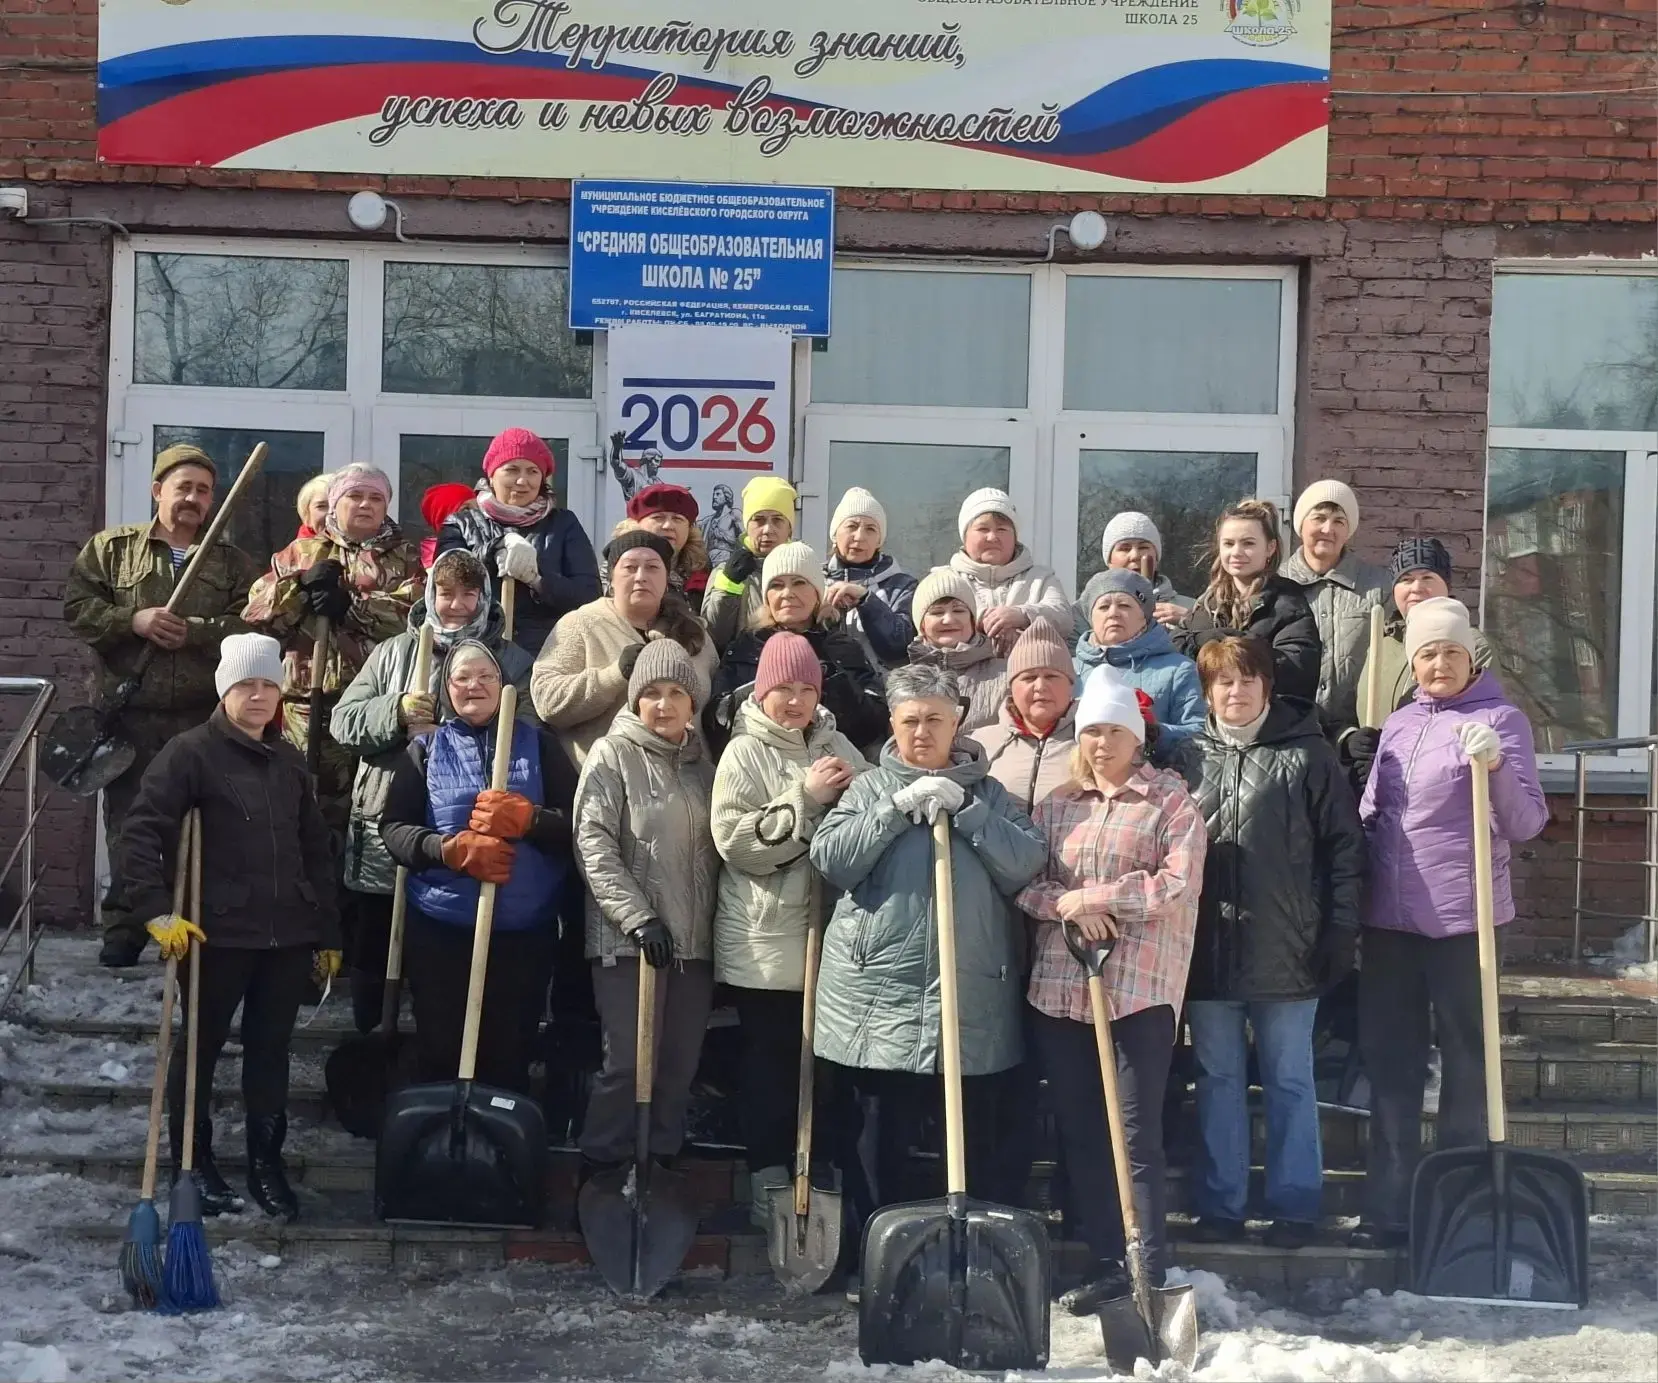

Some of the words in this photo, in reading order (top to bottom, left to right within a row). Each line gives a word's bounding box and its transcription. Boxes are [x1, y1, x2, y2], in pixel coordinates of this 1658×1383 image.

[1125, 13, 1178, 25] ШКОЛА
[1182, 14, 1198, 25] 25
[473, 0, 795, 71] Территория
[794, 22, 966, 77] знаний,
[369, 94, 524, 145] успеха
[537, 100, 570, 130] и
[578, 72, 712, 137] новых
[723, 75, 1062, 157] возможностей
[581, 190, 658, 202] МУНИЦИПАЛЬНОЕ
[659, 192, 715, 204] БЮДЖЕТНОЕ
[716, 195, 825, 208] ОБЩЕОБРАЗОВАТЕЛЬНОЕ
[591, 204, 649, 216] УЧРЕЖДЕНИЕ
[650, 206, 717, 217] КИСЕЛЁВСКОГО
[719, 208, 775, 220] ГОРОДСКОГО
[776, 210, 809, 221] ОКРУГА
[650, 233, 823, 260] ОБЩЕОБРАЗОВАТЕЛЬНАЯ
[642, 265, 705, 289] ШКОЛА
[709, 268, 728, 290] №
[623, 299, 677, 308] РОССИЙСКАЯ
[732, 302, 791, 311] КЕМЕРОВСКАЯ
[621, 393, 776, 454] 2026
